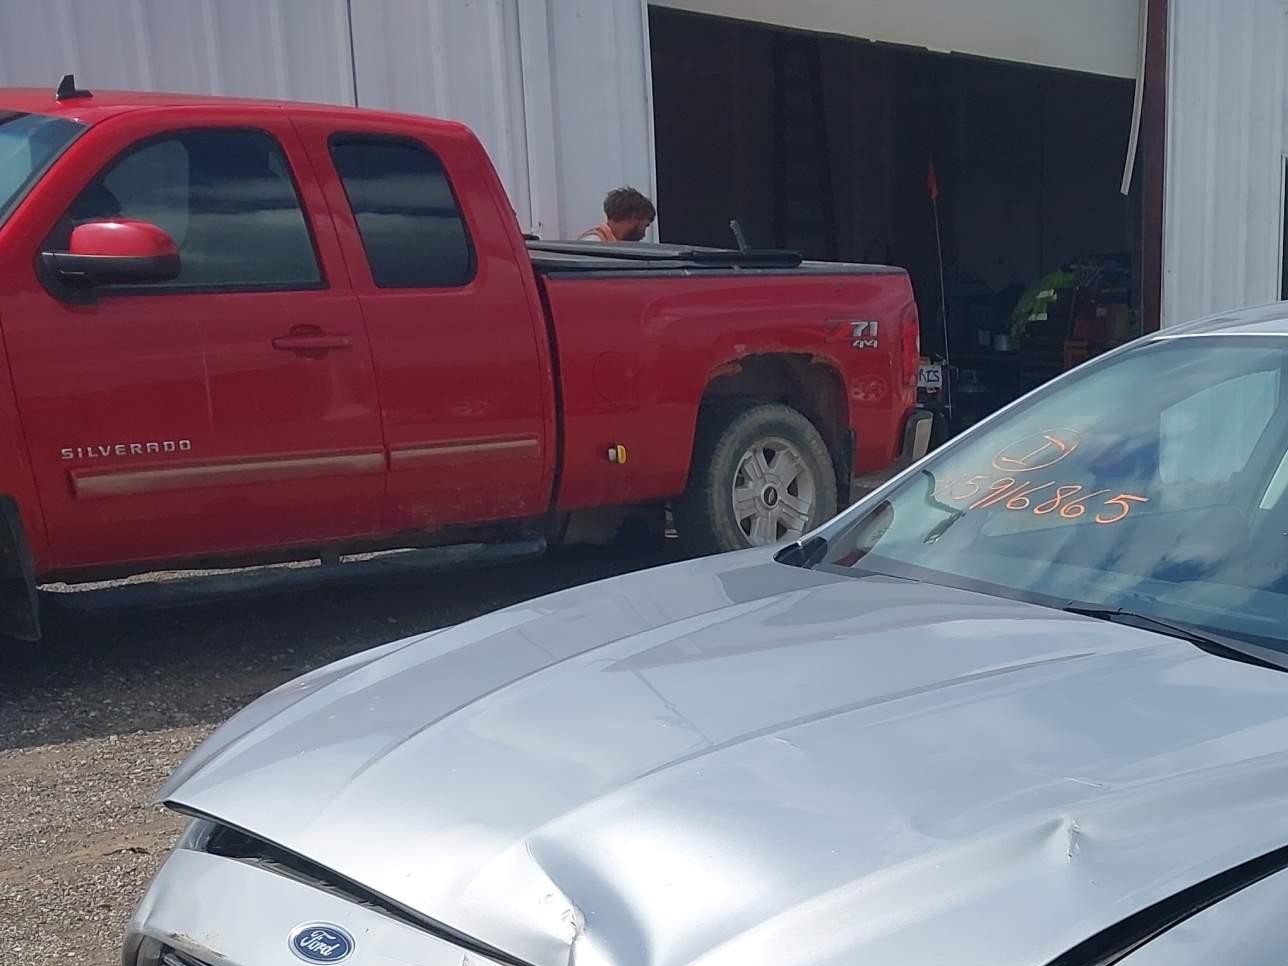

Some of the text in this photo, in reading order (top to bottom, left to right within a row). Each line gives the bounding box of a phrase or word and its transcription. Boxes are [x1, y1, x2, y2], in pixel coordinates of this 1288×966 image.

[60, 439, 192, 460] SILVERADO
[935, 475, 1150, 525] 5916865
[300, 930, 340, 956] Ford
